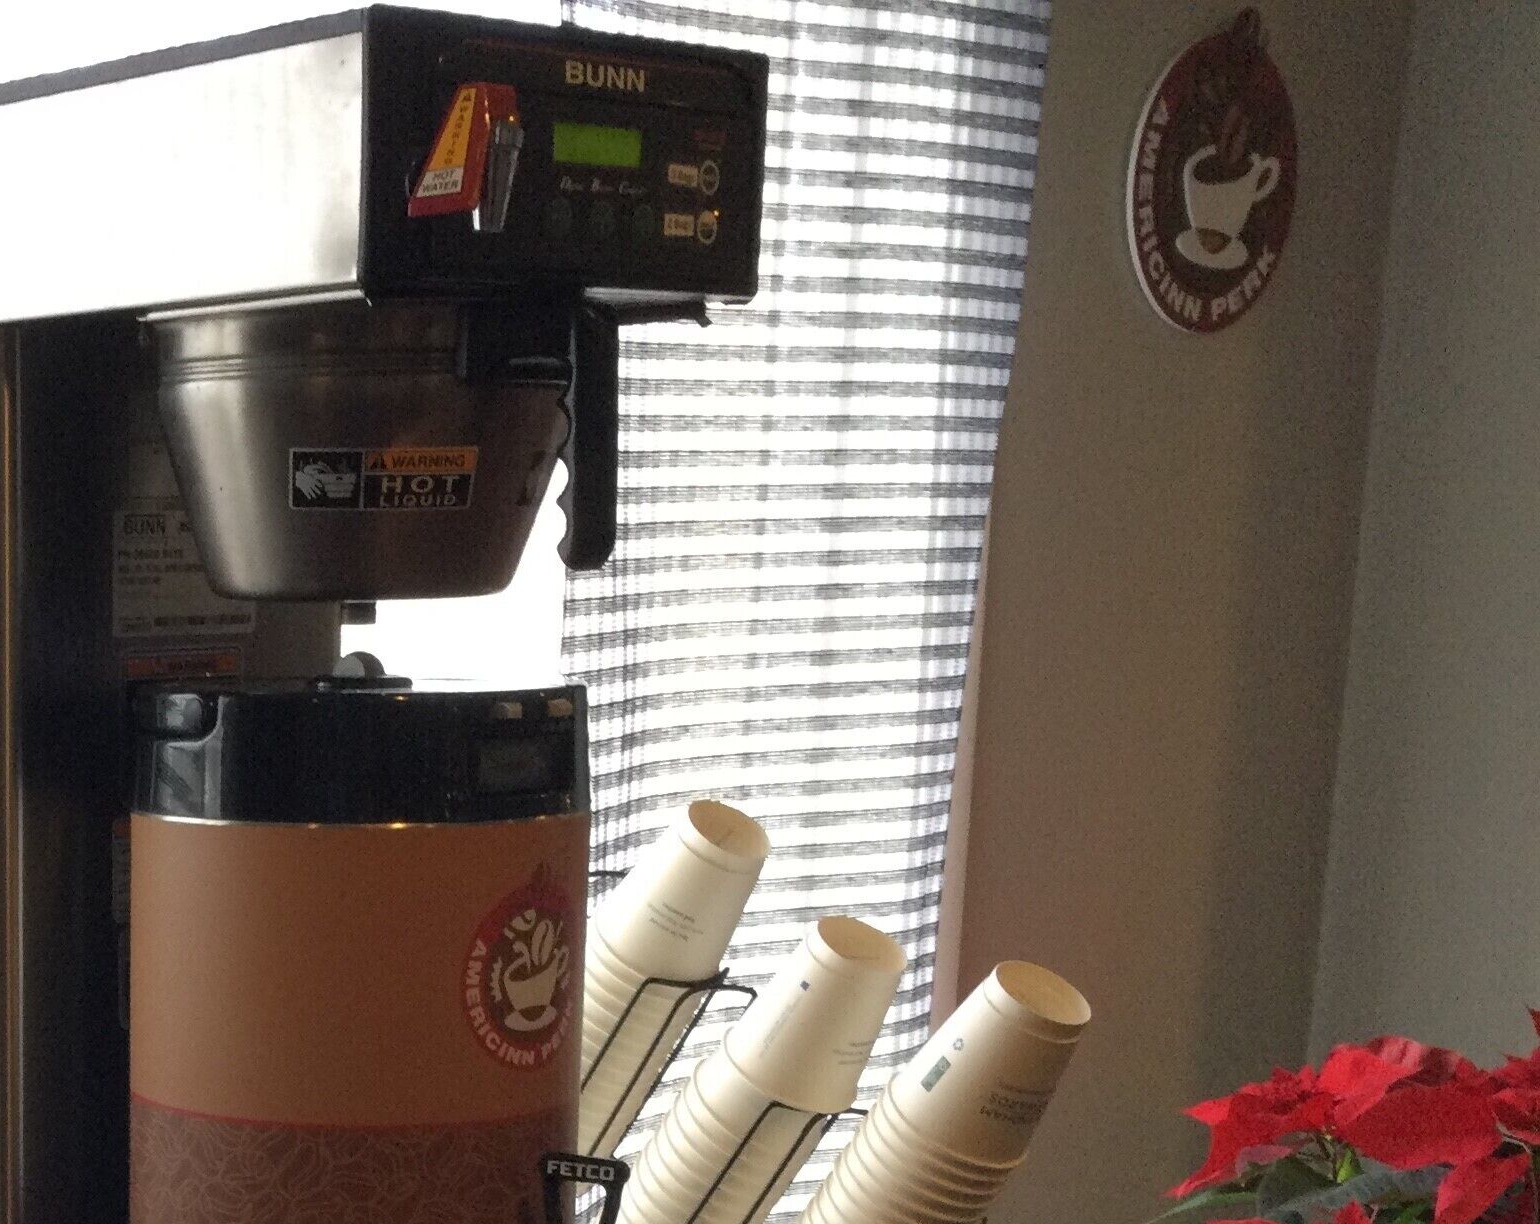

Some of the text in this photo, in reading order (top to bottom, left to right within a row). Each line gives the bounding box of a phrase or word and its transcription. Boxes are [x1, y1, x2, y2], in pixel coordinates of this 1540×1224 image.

[564, 59, 646, 93] BUNN
[432, 169, 457, 182] HOT
[422, 179, 459, 194] WATER
[390, 453, 466, 470] WARNING
[381, 475, 460, 494] HOT
[379, 493, 457, 508] LIQUID
[464, 937, 535, 1066] AMERICINN
[546, 1159, 615, 1182] FETCO
